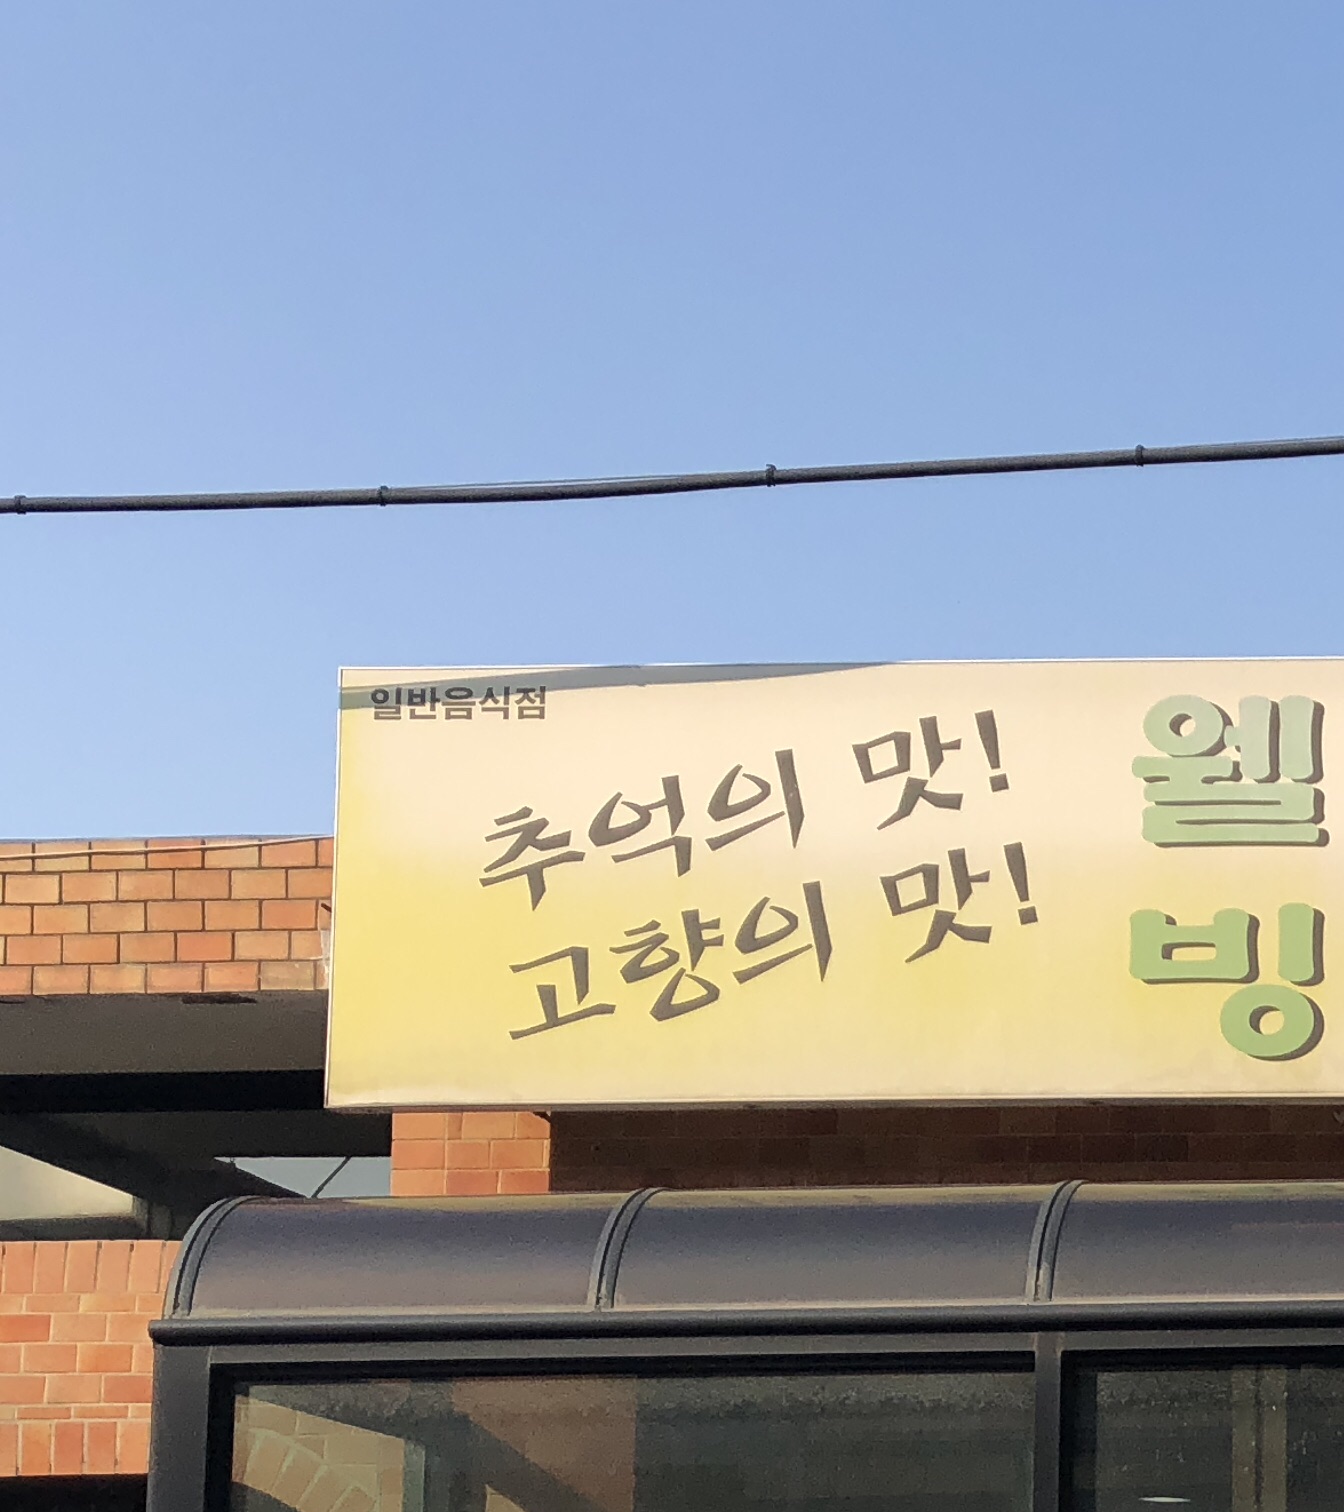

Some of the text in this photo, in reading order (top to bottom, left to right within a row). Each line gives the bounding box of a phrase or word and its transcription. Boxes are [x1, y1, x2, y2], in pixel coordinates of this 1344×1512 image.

[370, 685, 547, 720] 일반음식점
[479, 709, 1011, 911] 추억의 맛!
[509, 841, 1039, 1040] 고향의 맛!
